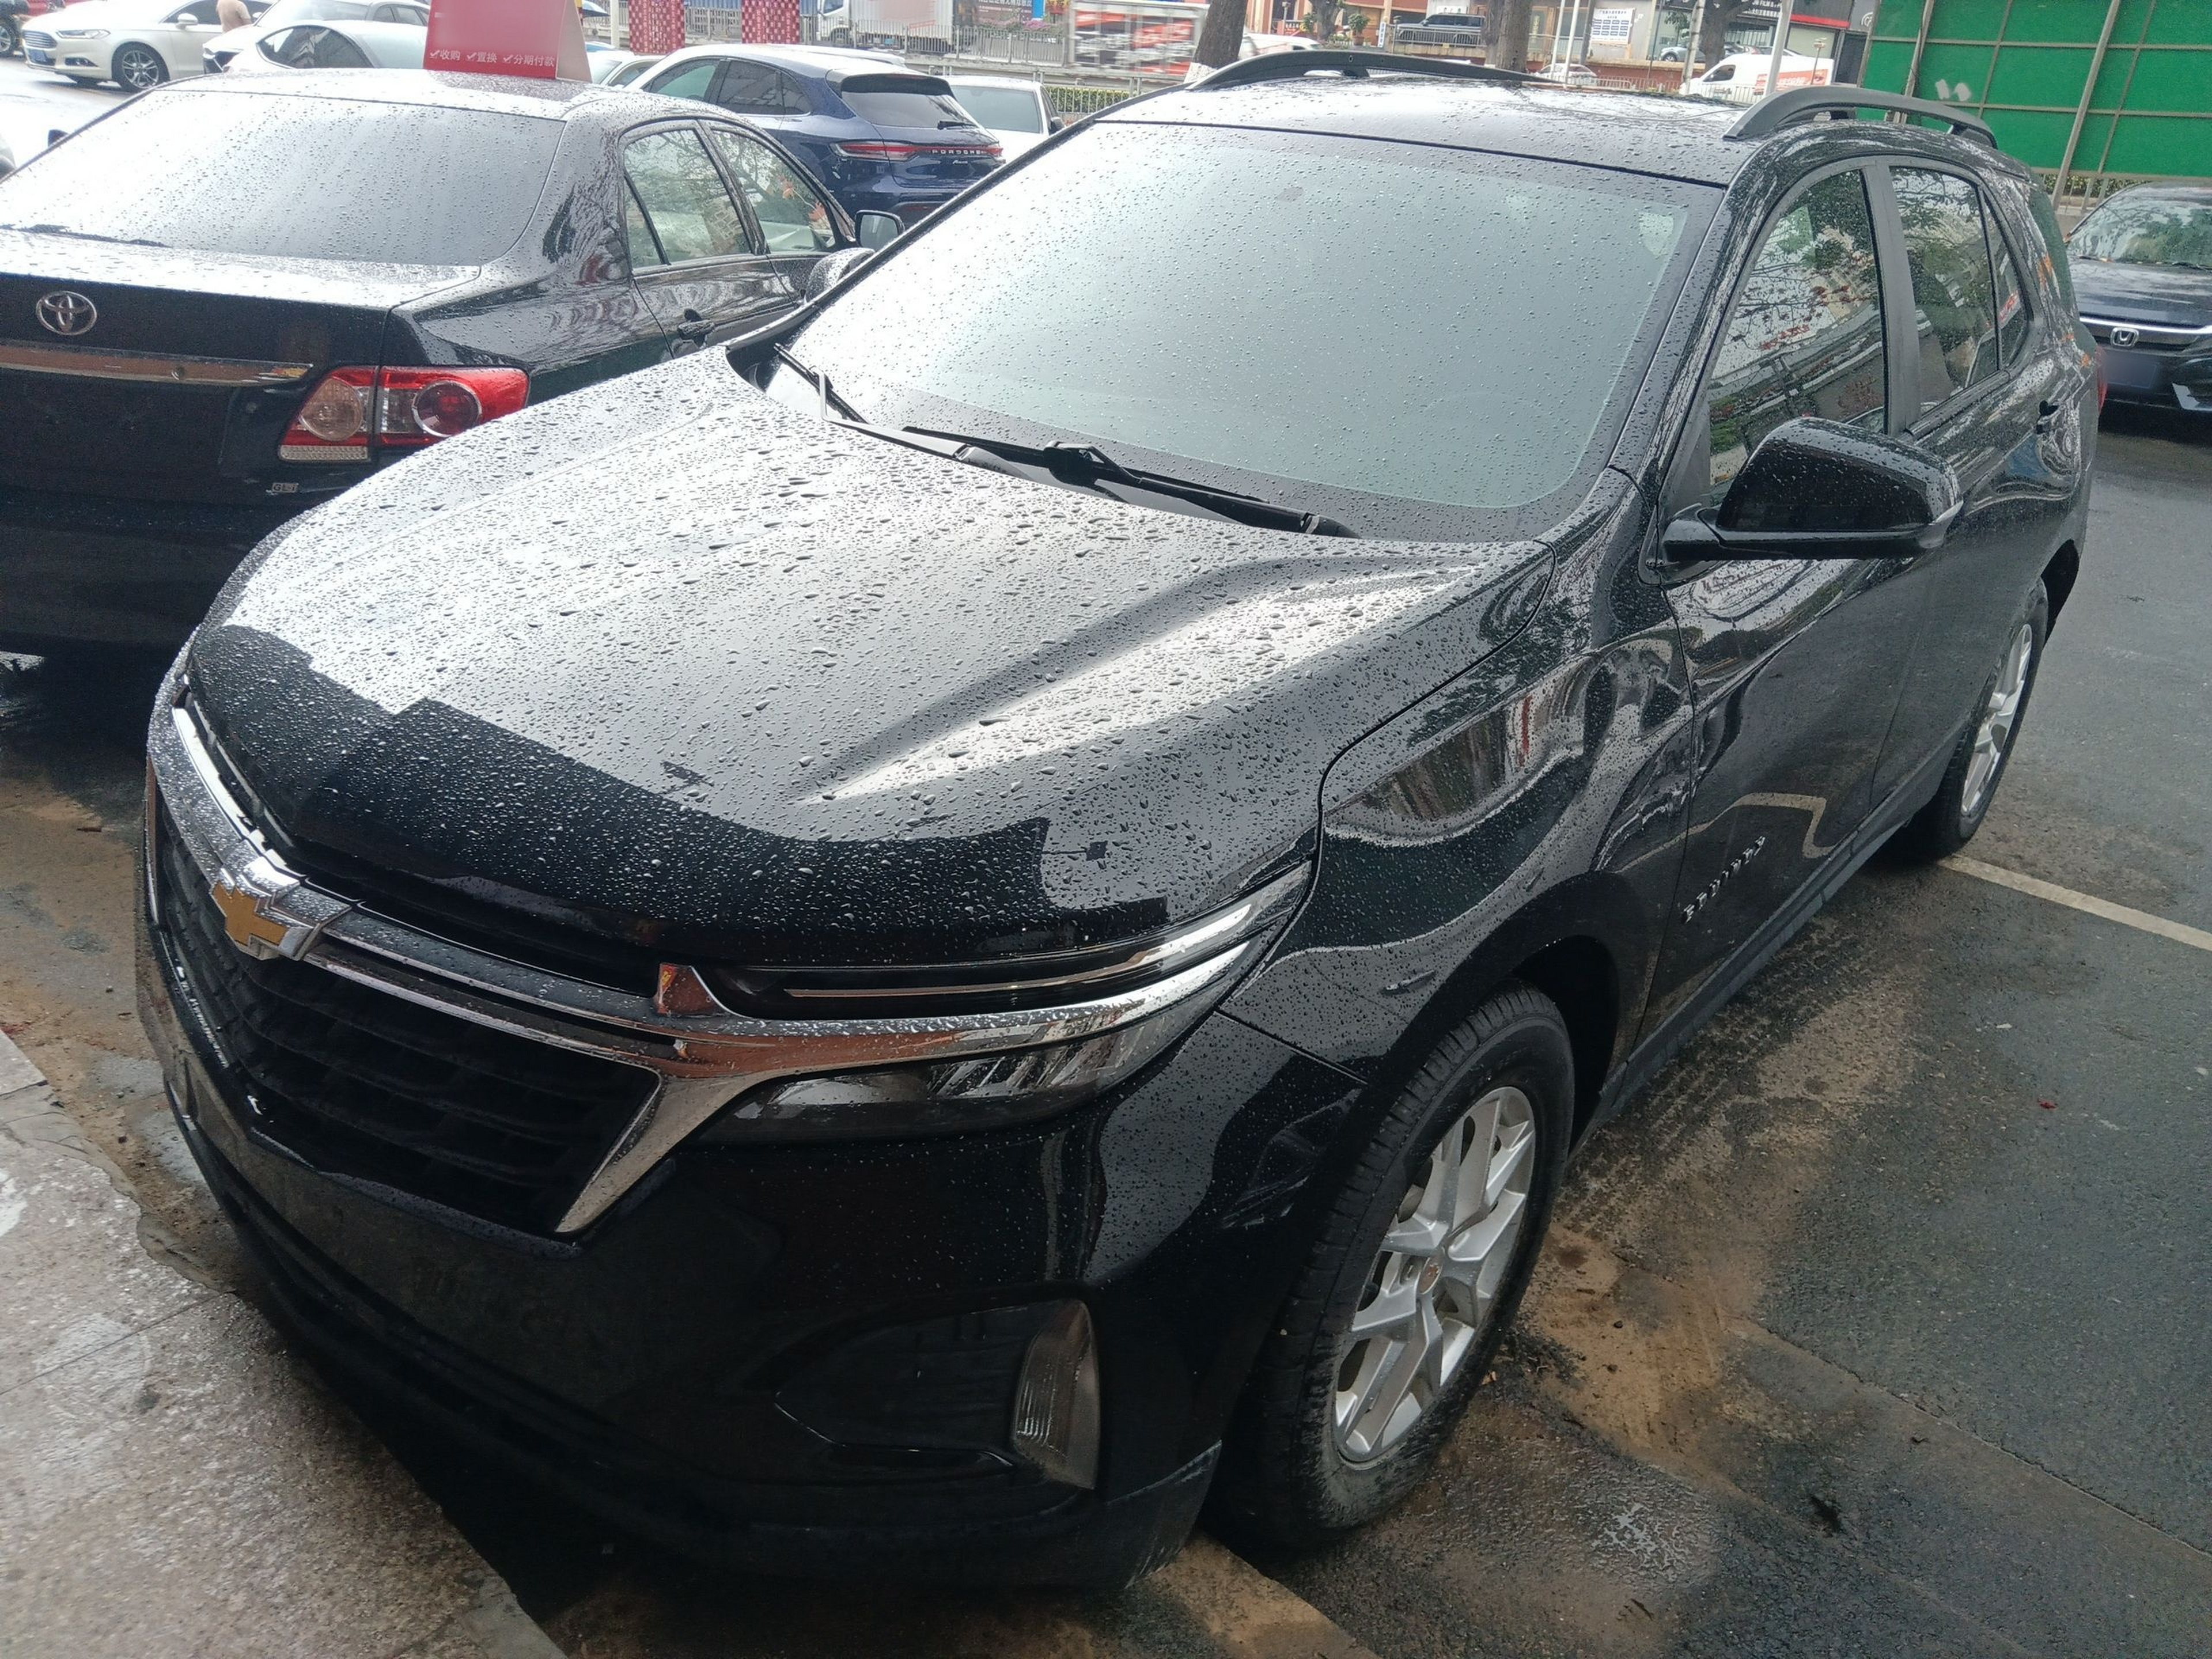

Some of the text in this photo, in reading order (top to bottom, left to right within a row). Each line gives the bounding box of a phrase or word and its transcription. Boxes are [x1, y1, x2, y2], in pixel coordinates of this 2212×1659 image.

[440, 49, 555, 67] 收购 置换 分期付款
